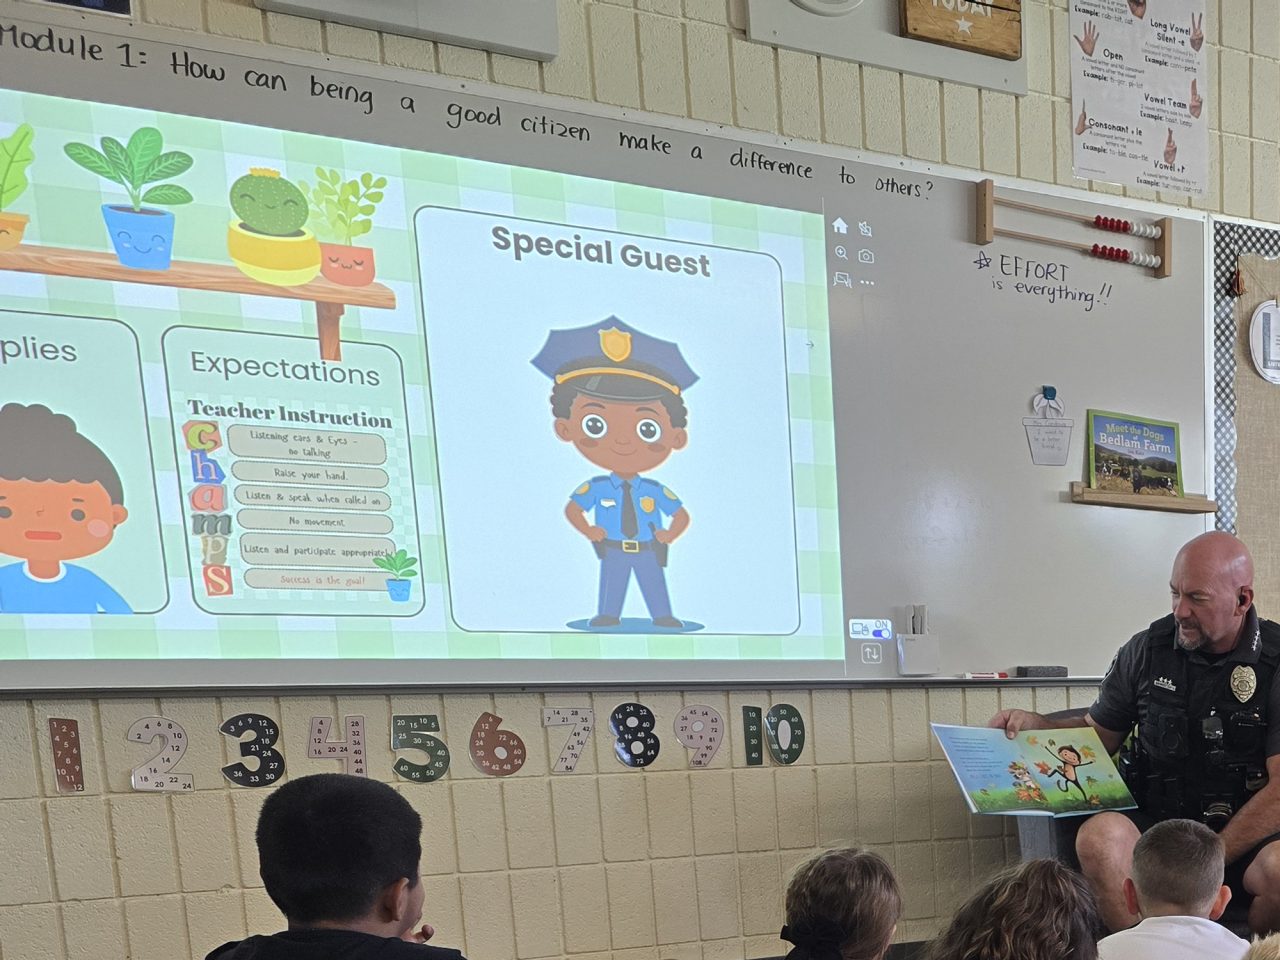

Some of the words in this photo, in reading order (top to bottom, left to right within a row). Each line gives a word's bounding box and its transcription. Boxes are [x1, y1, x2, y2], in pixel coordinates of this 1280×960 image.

[1150, 18, 1167, 32] Long
[1169, 22, 1191, 36] Vowel
[1156, 32, 1176, 44] Silent
[1103, 48, 1124, 61] Open
[1144, 92, 1166, 106] Vowel
[1167, 97, 1187, 109] Team
[0, 24, 103, 61] Module
[116, 43, 147, 68] 1:
[170, 51, 226, 82] How
[244, 69, 287, 92] can
[310, 75, 374, 115] being
[400, 96, 416, 113] a
[446, 103, 502, 129] good
[521, 116, 591, 141] citizen
[619, 131, 672, 155] make
[691, 146, 703, 160] a
[730, 147, 813, 179] difference
[839, 166, 856, 185] to
[875, 178, 934, 200] others?
[1088, 118, 1129, 134] Consonant
[1153, 160, 1175, 172] Vowel
[491, 225, 613, 265] Special
[620, 244, 711, 278] Guest
[1000, 254, 1070, 282] EFFORT
[991, 276, 1003, 290] is
[1014, 282, 1112, 312] everything!!
[191, 350, 381, 386] Expectations
[187, 399, 275, 421] Teacher
[279, 406, 393, 429] Instruction
[250, 430, 289, 443] Listening
[293, 435, 311, 443] ears
[328, 436, 348, 446] Eyes
[1106, 423, 1129, 435] Meet
[1130, 426, 1142, 436] the
[1143, 427, 1165, 442] Dogs
[1099, 432, 1141, 449] Bedlam
[1144, 439, 1171, 454] Farm
[289, 448, 299, 456] no
[302, 448, 331, 459] talking
[274, 468, 296, 478] Raise
[302, 471, 321, 480] your
[245, 490, 271, 500] Listen
[276, 492, 284, 500] &
[289, 493, 311, 502] speak
[316, 494, 340, 503] when
[344, 495, 366, 505] called
[289, 516, 300, 525] No
[304, 518, 345, 527] movement
[244, 544, 269, 554] Listen
[274, 545, 289, 555] and
[294, 546, 336, 557] participate
[280, 575, 311, 585] Success
[315, 575, 324, 585] is
[327, 575, 341, 585] the
[344, 576, 365, 587] goal!
[874, 620, 888, 629] ON
[48, 717, 84, 793] 1
[127, 716, 195, 792] 2
[218, 712, 286, 788] 3
[307, 715, 368, 778] 4
[391, 714, 451, 783] 5
[469, 711, 527, 777] 6
[543, 707, 594, 773] 7
[608, 702, 661, 768] 8
[673, 704, 725, 767] 9
[742, 703, 806, 766] 10
